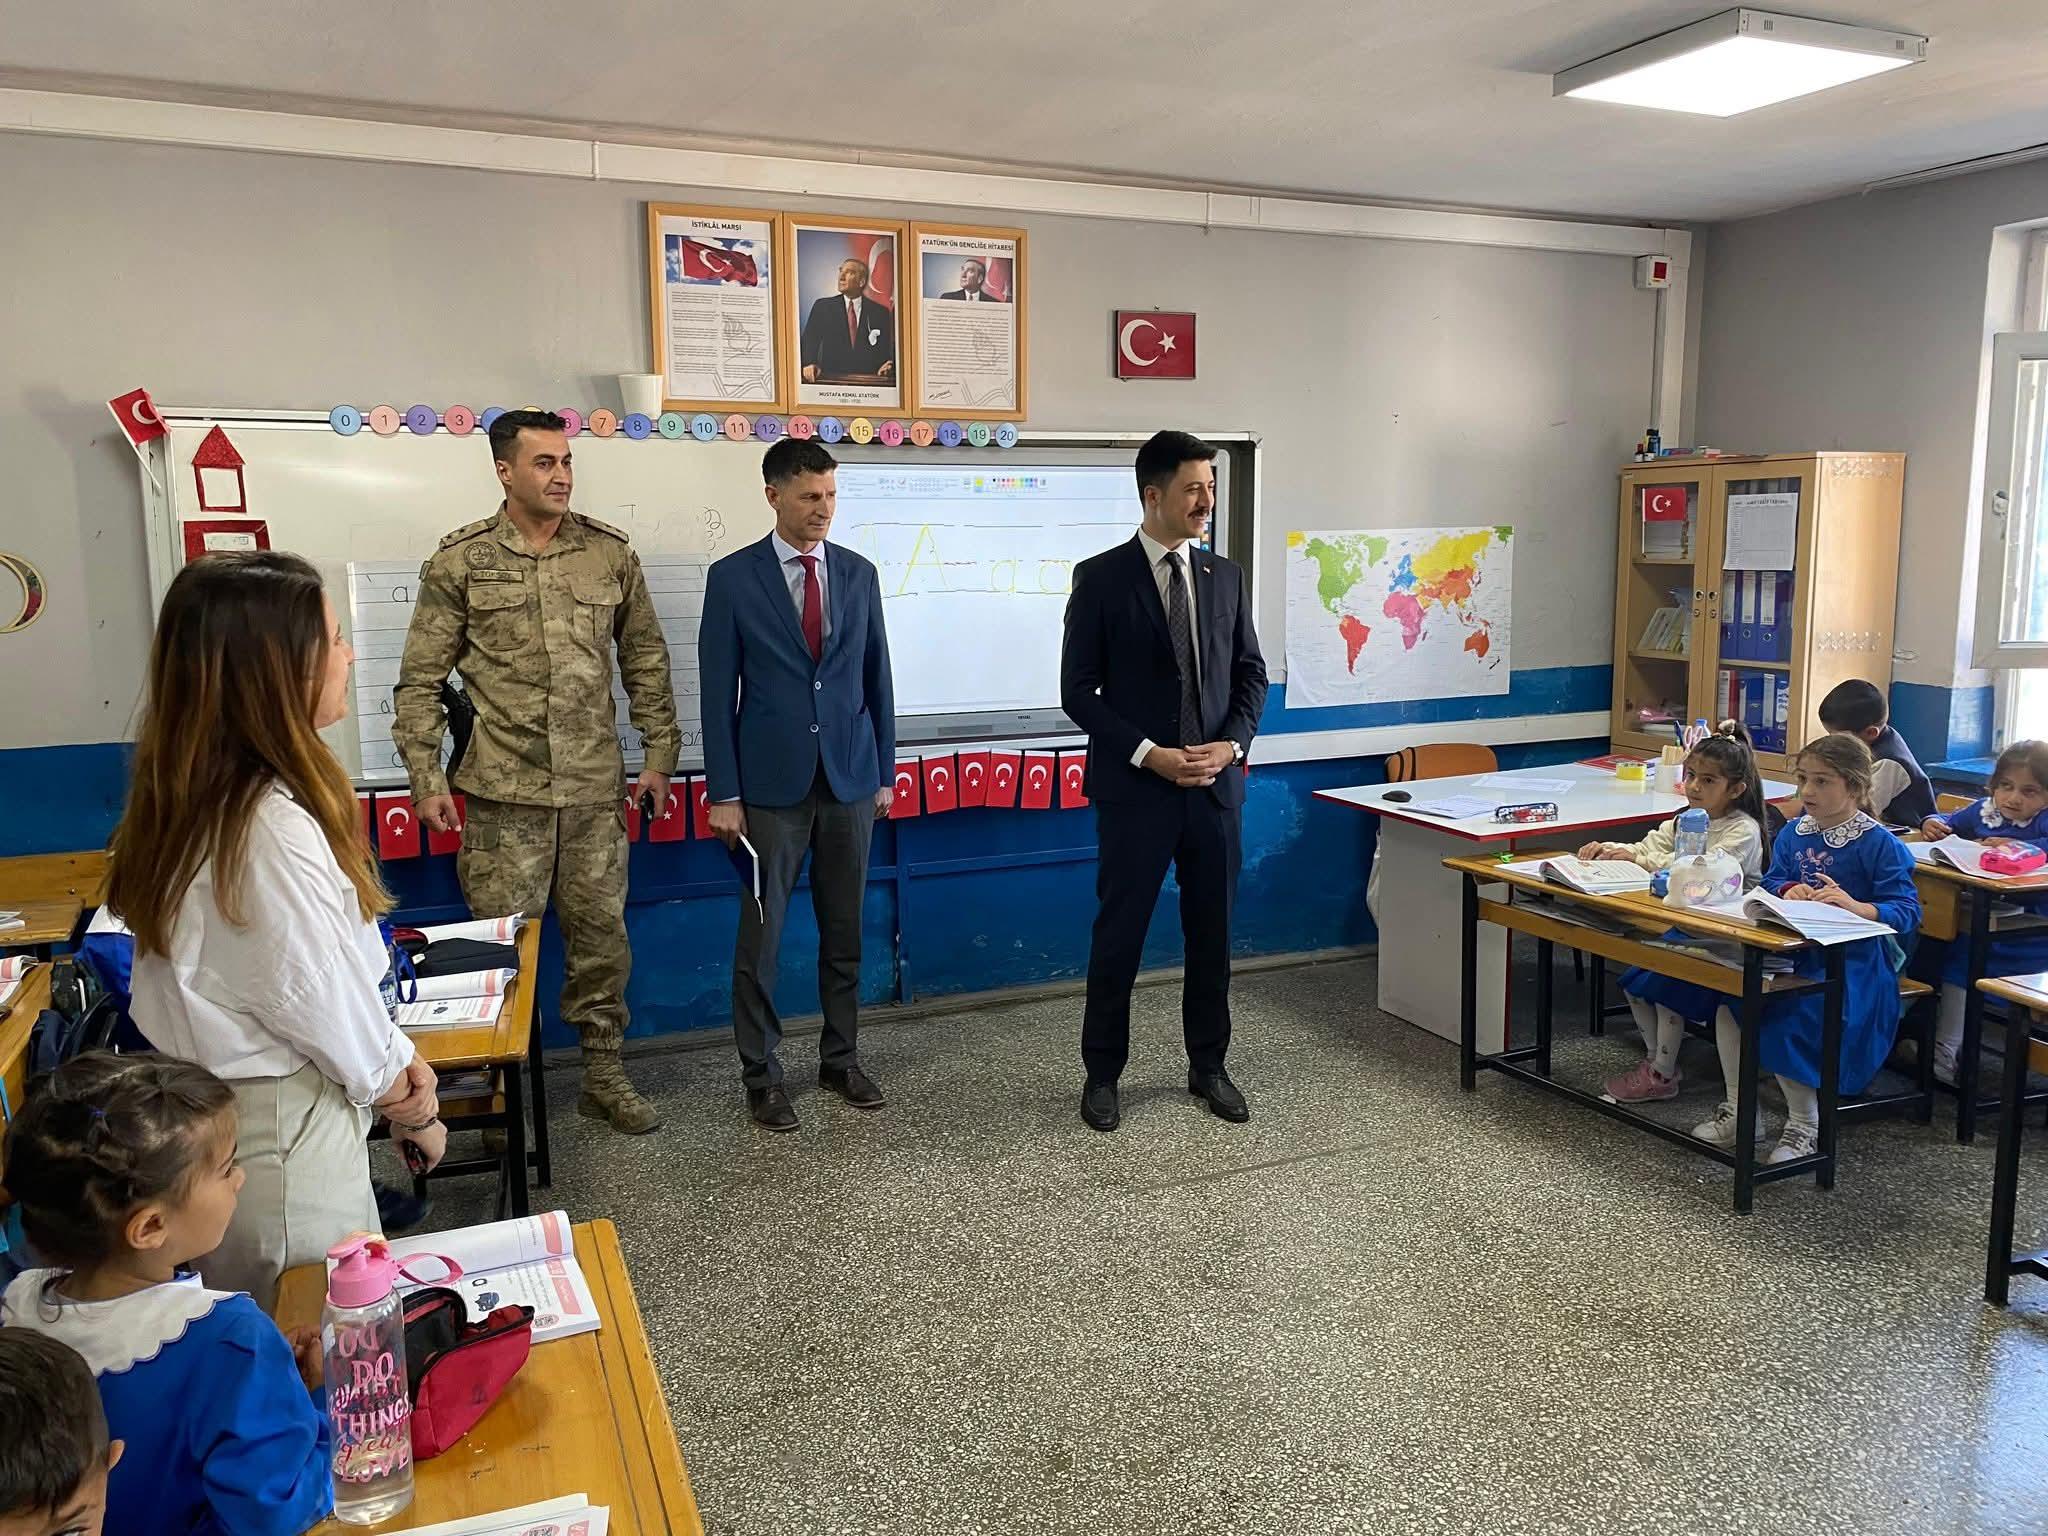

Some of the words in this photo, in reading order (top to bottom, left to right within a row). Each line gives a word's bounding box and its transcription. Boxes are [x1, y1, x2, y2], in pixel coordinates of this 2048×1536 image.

[341, 415, 350, 426] 0
[381, 415, 388, 426] 1
[417, 415, 427, 426] 2
[455, 415, 464, 426] 3
[599, 418, 607, 429] 7
[633, 420, 642, 432] 8
[667, 420, 676, 431] 9
[697, 422, 713, 434] 10
[731, 423, 745, 433] 11
[762, 423, 776, 434] 12
[794, 423, 809, 434] 13
[824, 424, 838, 436] 14
[856, 426, 869, 436] 15
[886, 428, 899, 439] 16
[916, 428, 929, 439] 17
[944, 429, 957, 440] 18
[973, 429, 986, 440] 19
[1000, 430, 1014, 442] 20
[897, 523, 950, 596] A
[352, 1352, 394, 1387] DO
[334, 1391, 409, 1435] THINGS
